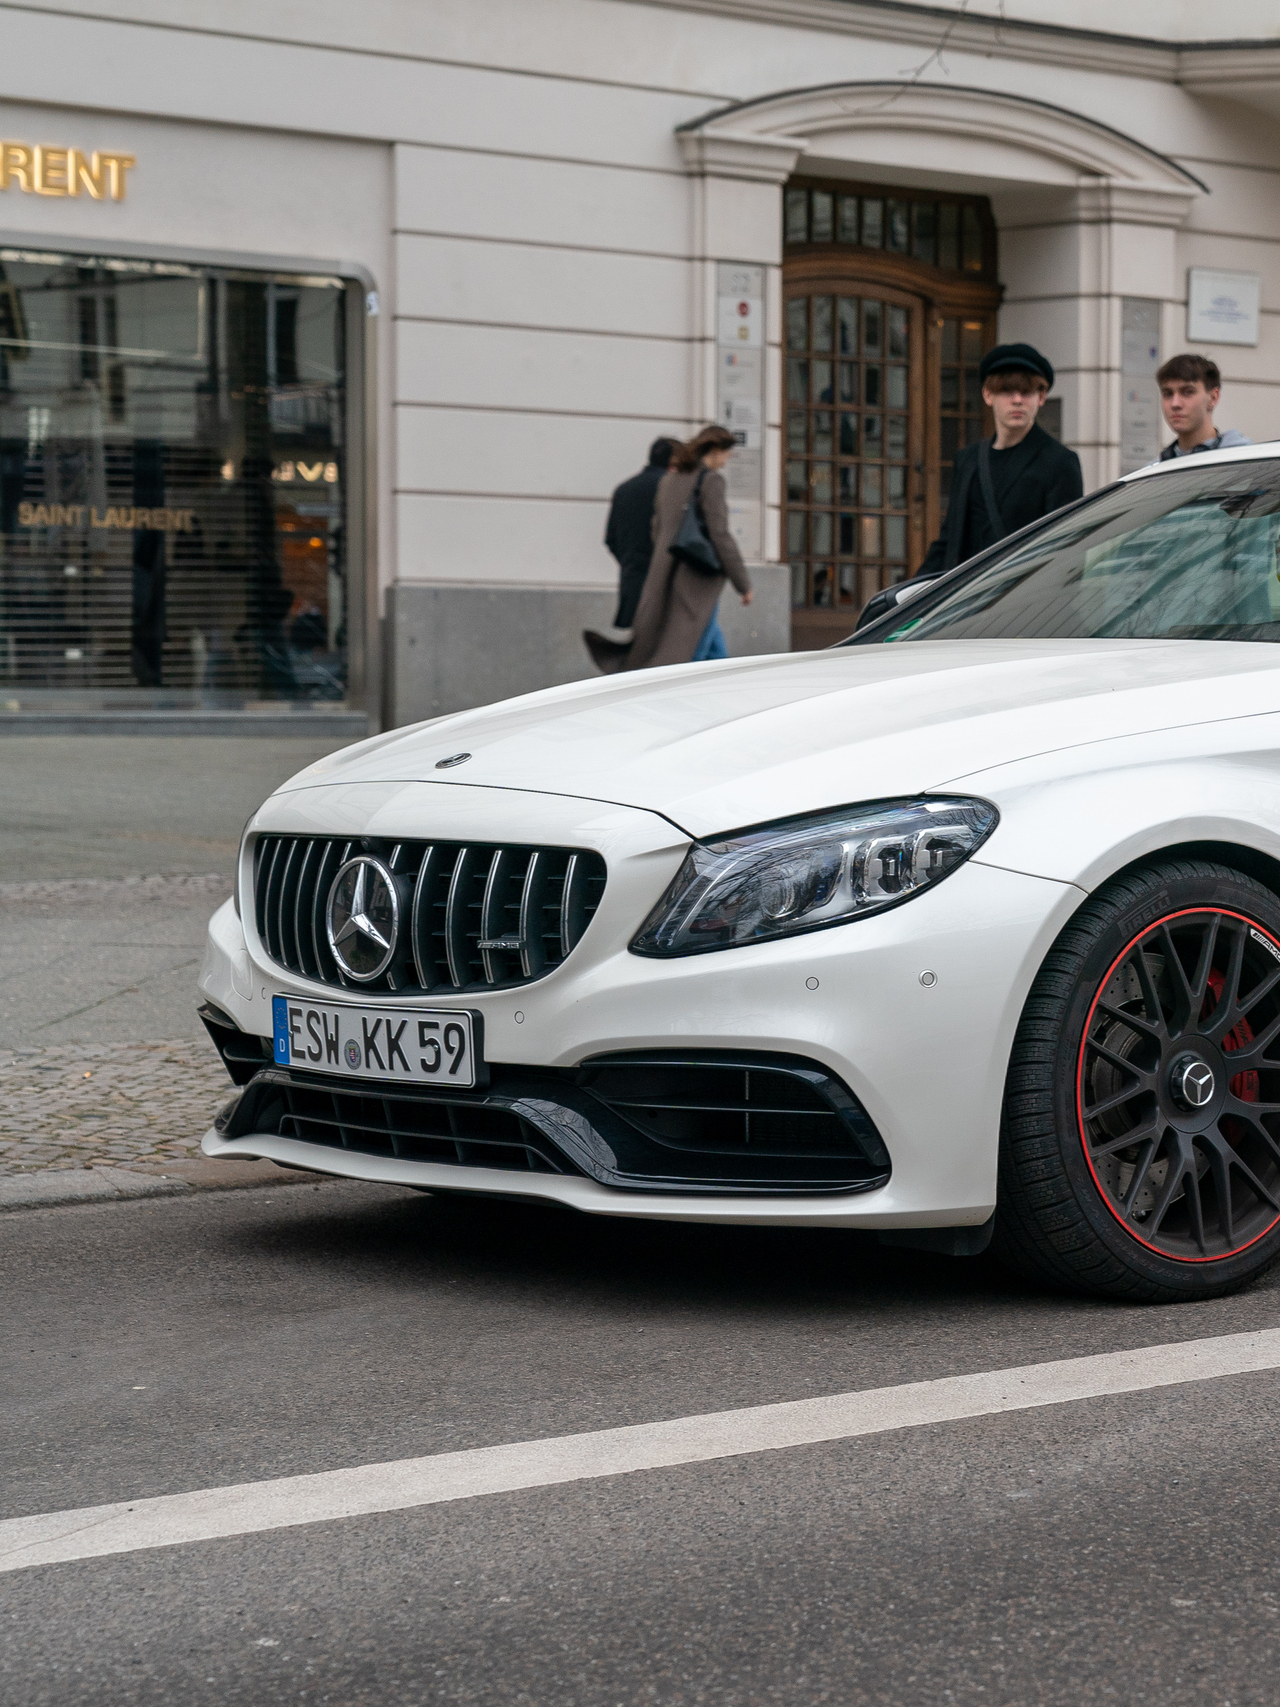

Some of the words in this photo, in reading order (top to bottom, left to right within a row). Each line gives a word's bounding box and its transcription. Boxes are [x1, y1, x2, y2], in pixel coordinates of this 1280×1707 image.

[0, 143, 135, 200] RENT
[18, 502, 84, 527] SAINT
[90, 506, 196, 532] LAURENT
[1117, 889, 1171, 938] PIRELLI
[279, 1038, 286, 1053] D
[289, 1007, 340, 1065] ESW
[362, 1016, 411, 1072] KK
[418, 1020, 466, 1075] 59
